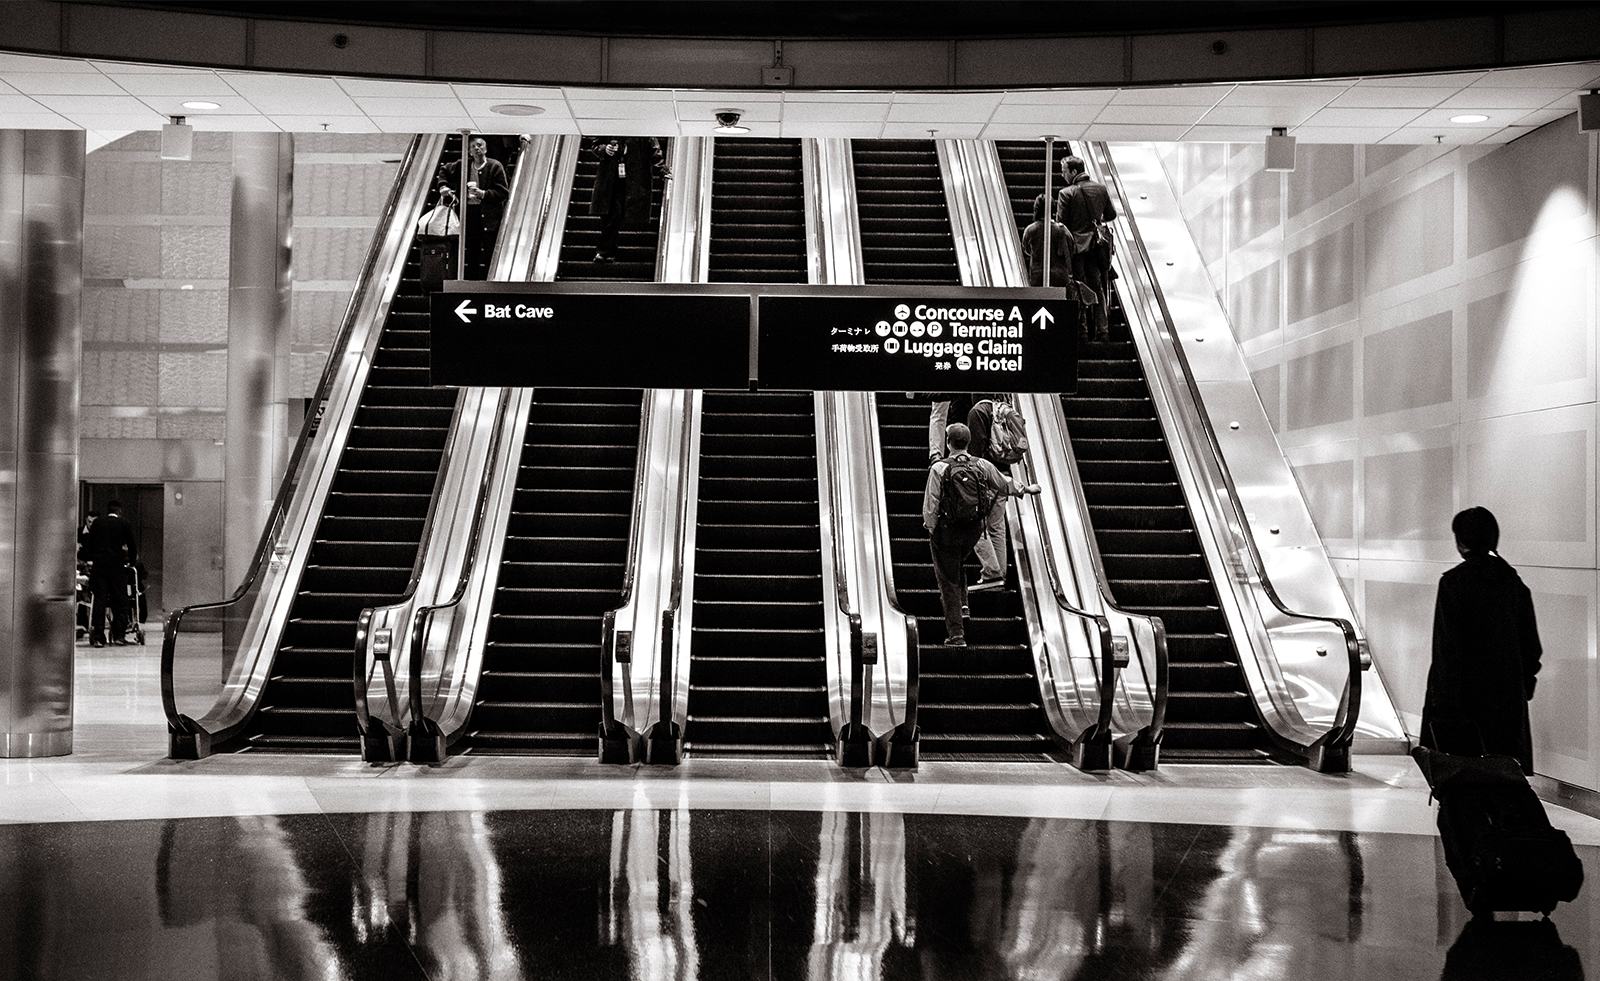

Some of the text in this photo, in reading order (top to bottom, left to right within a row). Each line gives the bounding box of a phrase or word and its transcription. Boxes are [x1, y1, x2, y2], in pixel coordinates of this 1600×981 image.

[484, 304, 554, 318] Bat Cave
[914, 304, 1023, 321] Concourse A
[949, 322, 1023, 338] Terminal
[904, 339, 1023, 357] Luggage Claim
[976, 355, 1023, 371] Hotel
